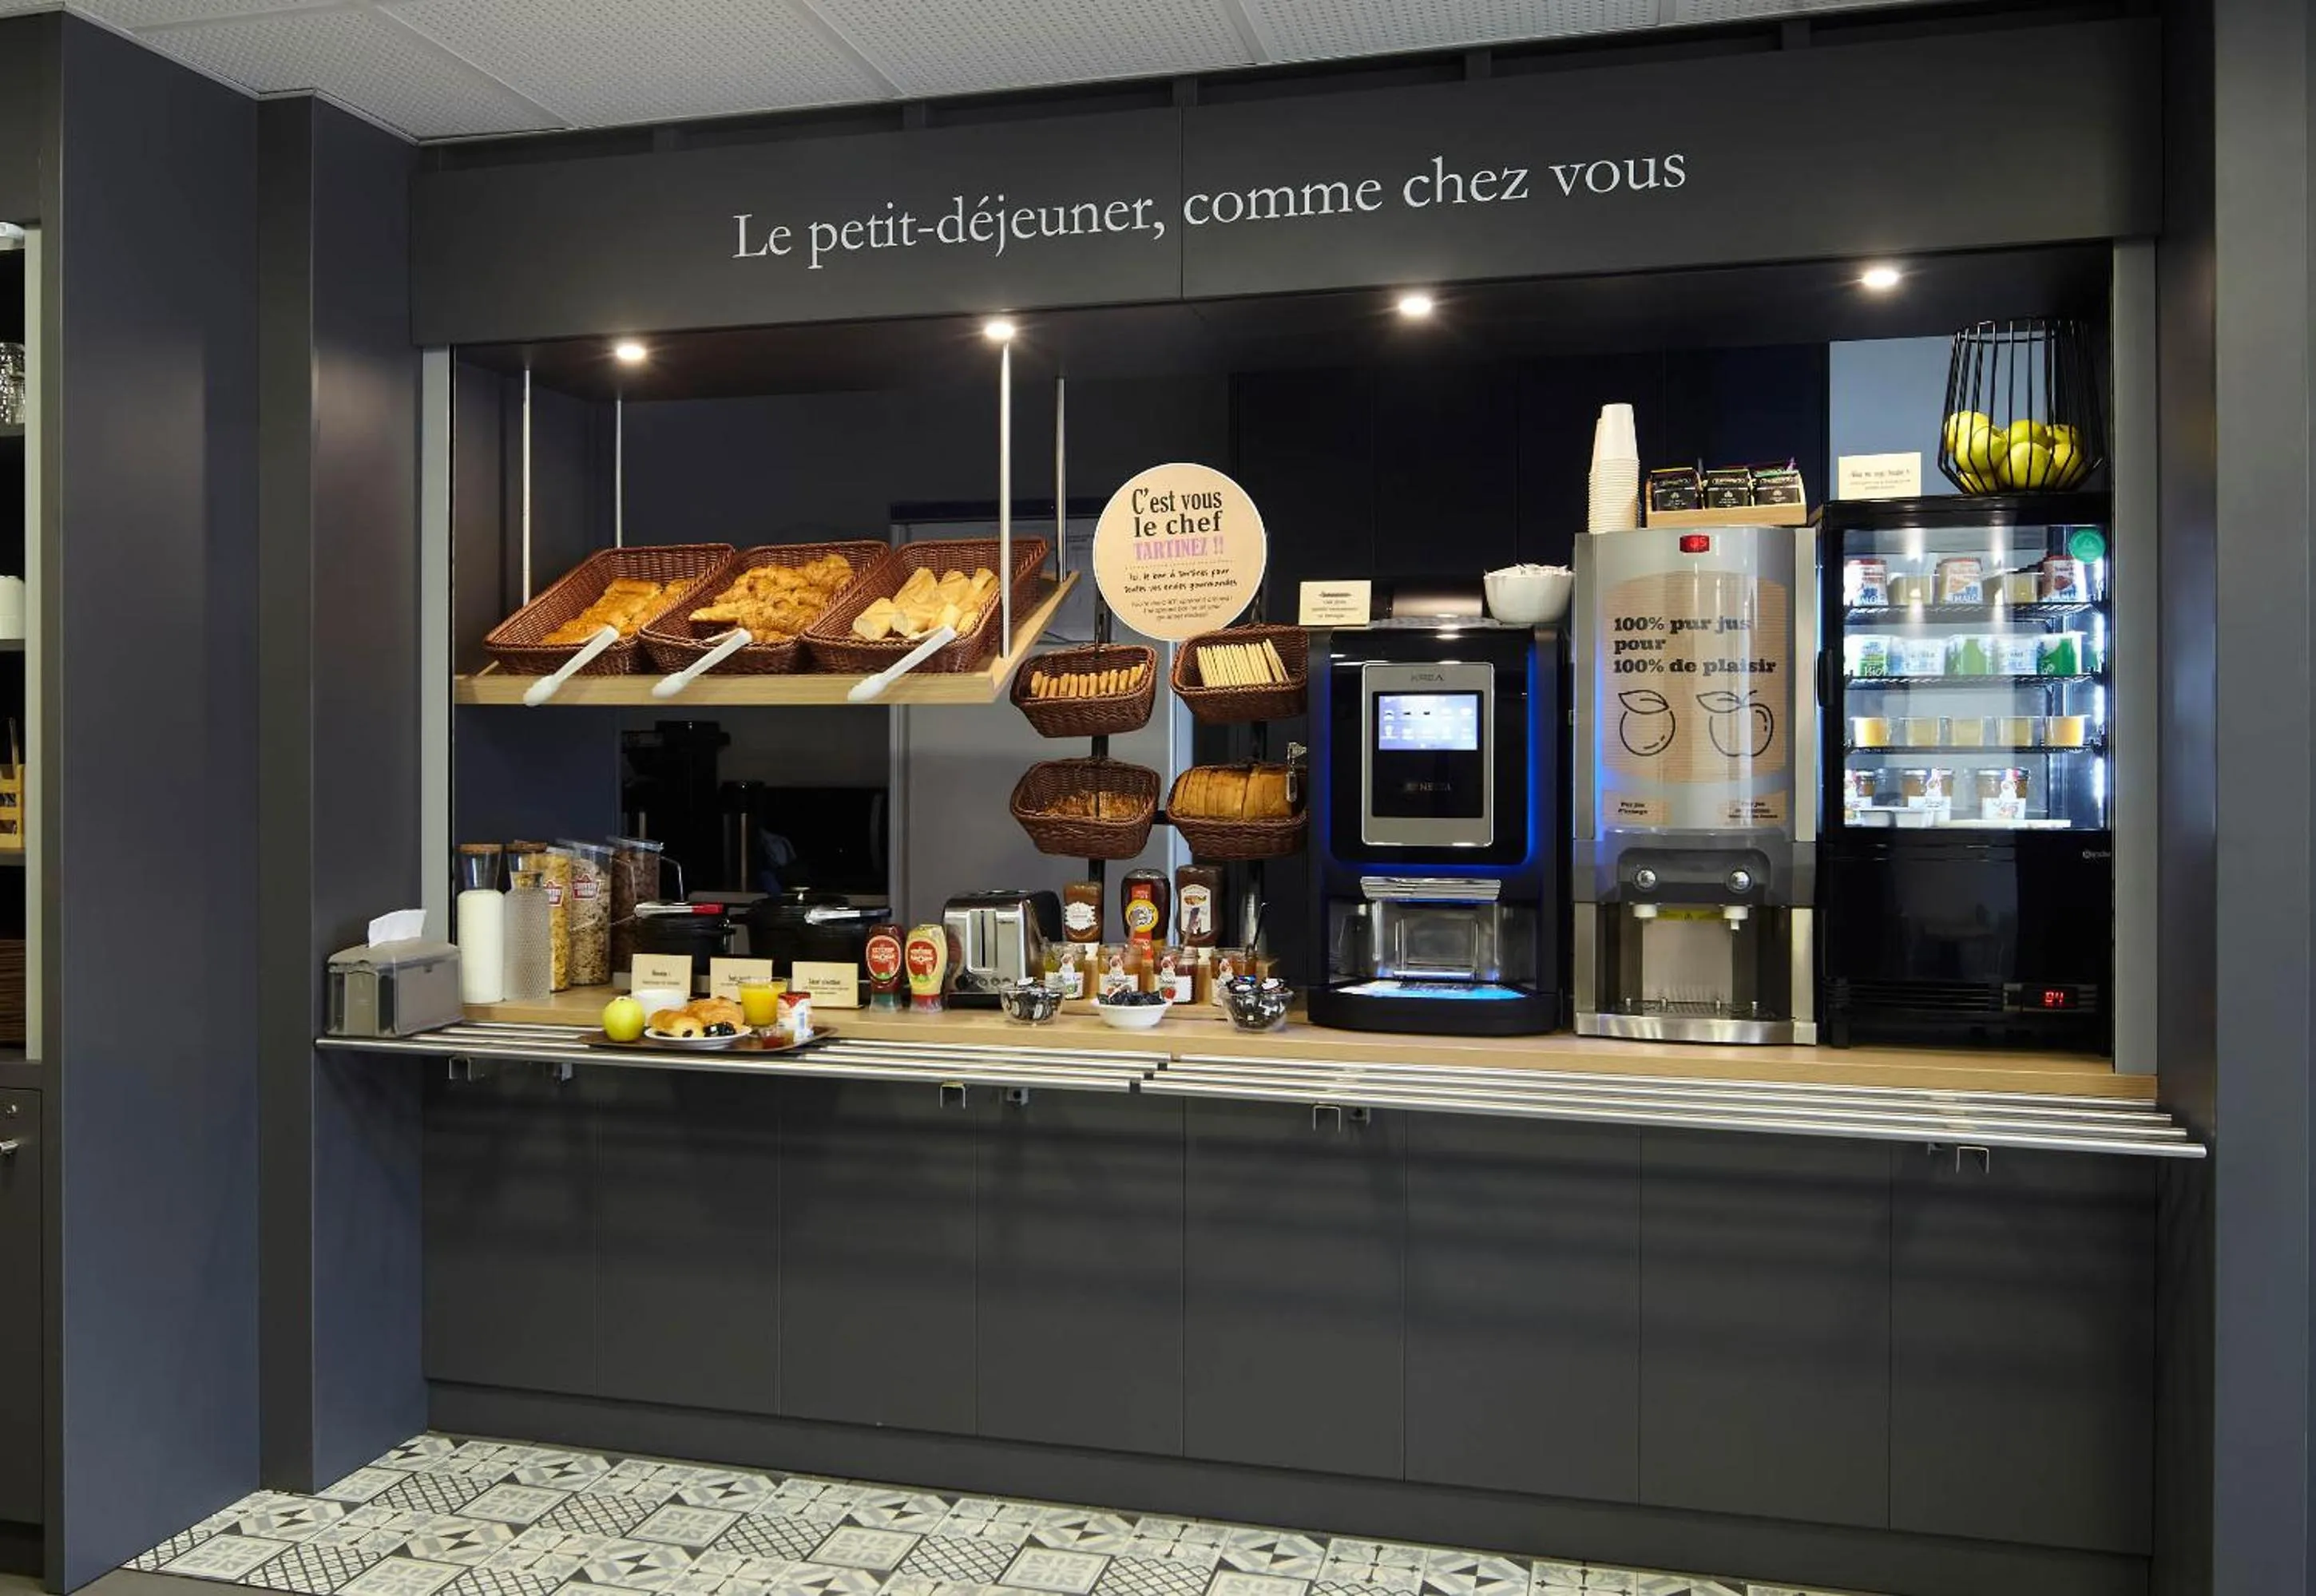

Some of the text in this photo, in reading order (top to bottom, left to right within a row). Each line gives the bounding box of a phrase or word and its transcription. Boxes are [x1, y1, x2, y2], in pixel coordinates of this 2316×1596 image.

[732, 153, 1687, 270] Le petit-déjeuner, comme chez vous
[1181, 491, 1223, 510] vous
[1133, 510, 1223, 537] le chef
[1133, 537, 1208, 560] TARTINEZ
[1613, 615, 1752, 635] 100% pur jus
[1613, 638, 1667, 655] pour
[1613, 658, 1776, 677] 100% de plaisir
